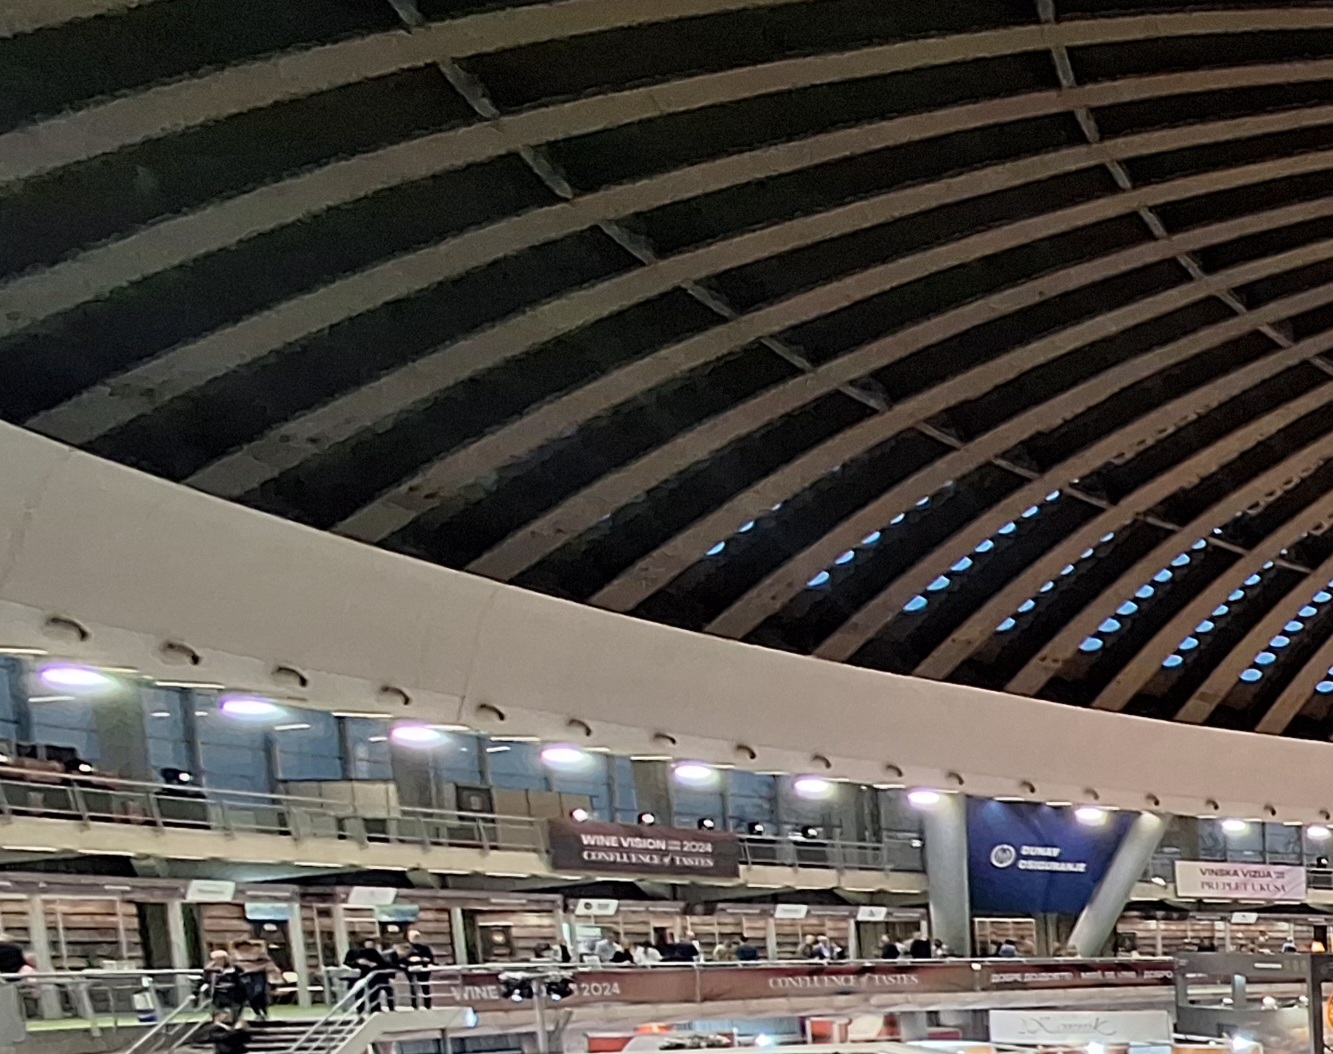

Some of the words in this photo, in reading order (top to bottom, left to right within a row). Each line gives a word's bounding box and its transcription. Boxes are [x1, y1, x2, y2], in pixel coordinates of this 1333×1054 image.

[581, 834, 620, 847] WINE
[620, 836, 666, 850] VISION
[683, 841, 713, 853] 2024
[582, 850, 661, 864] CONFLUENCE
[674, 856, 714, 867] TASTES
[1200, 868, 1240, 877] VINSKA
[580, 982, 621, 996] 2024
